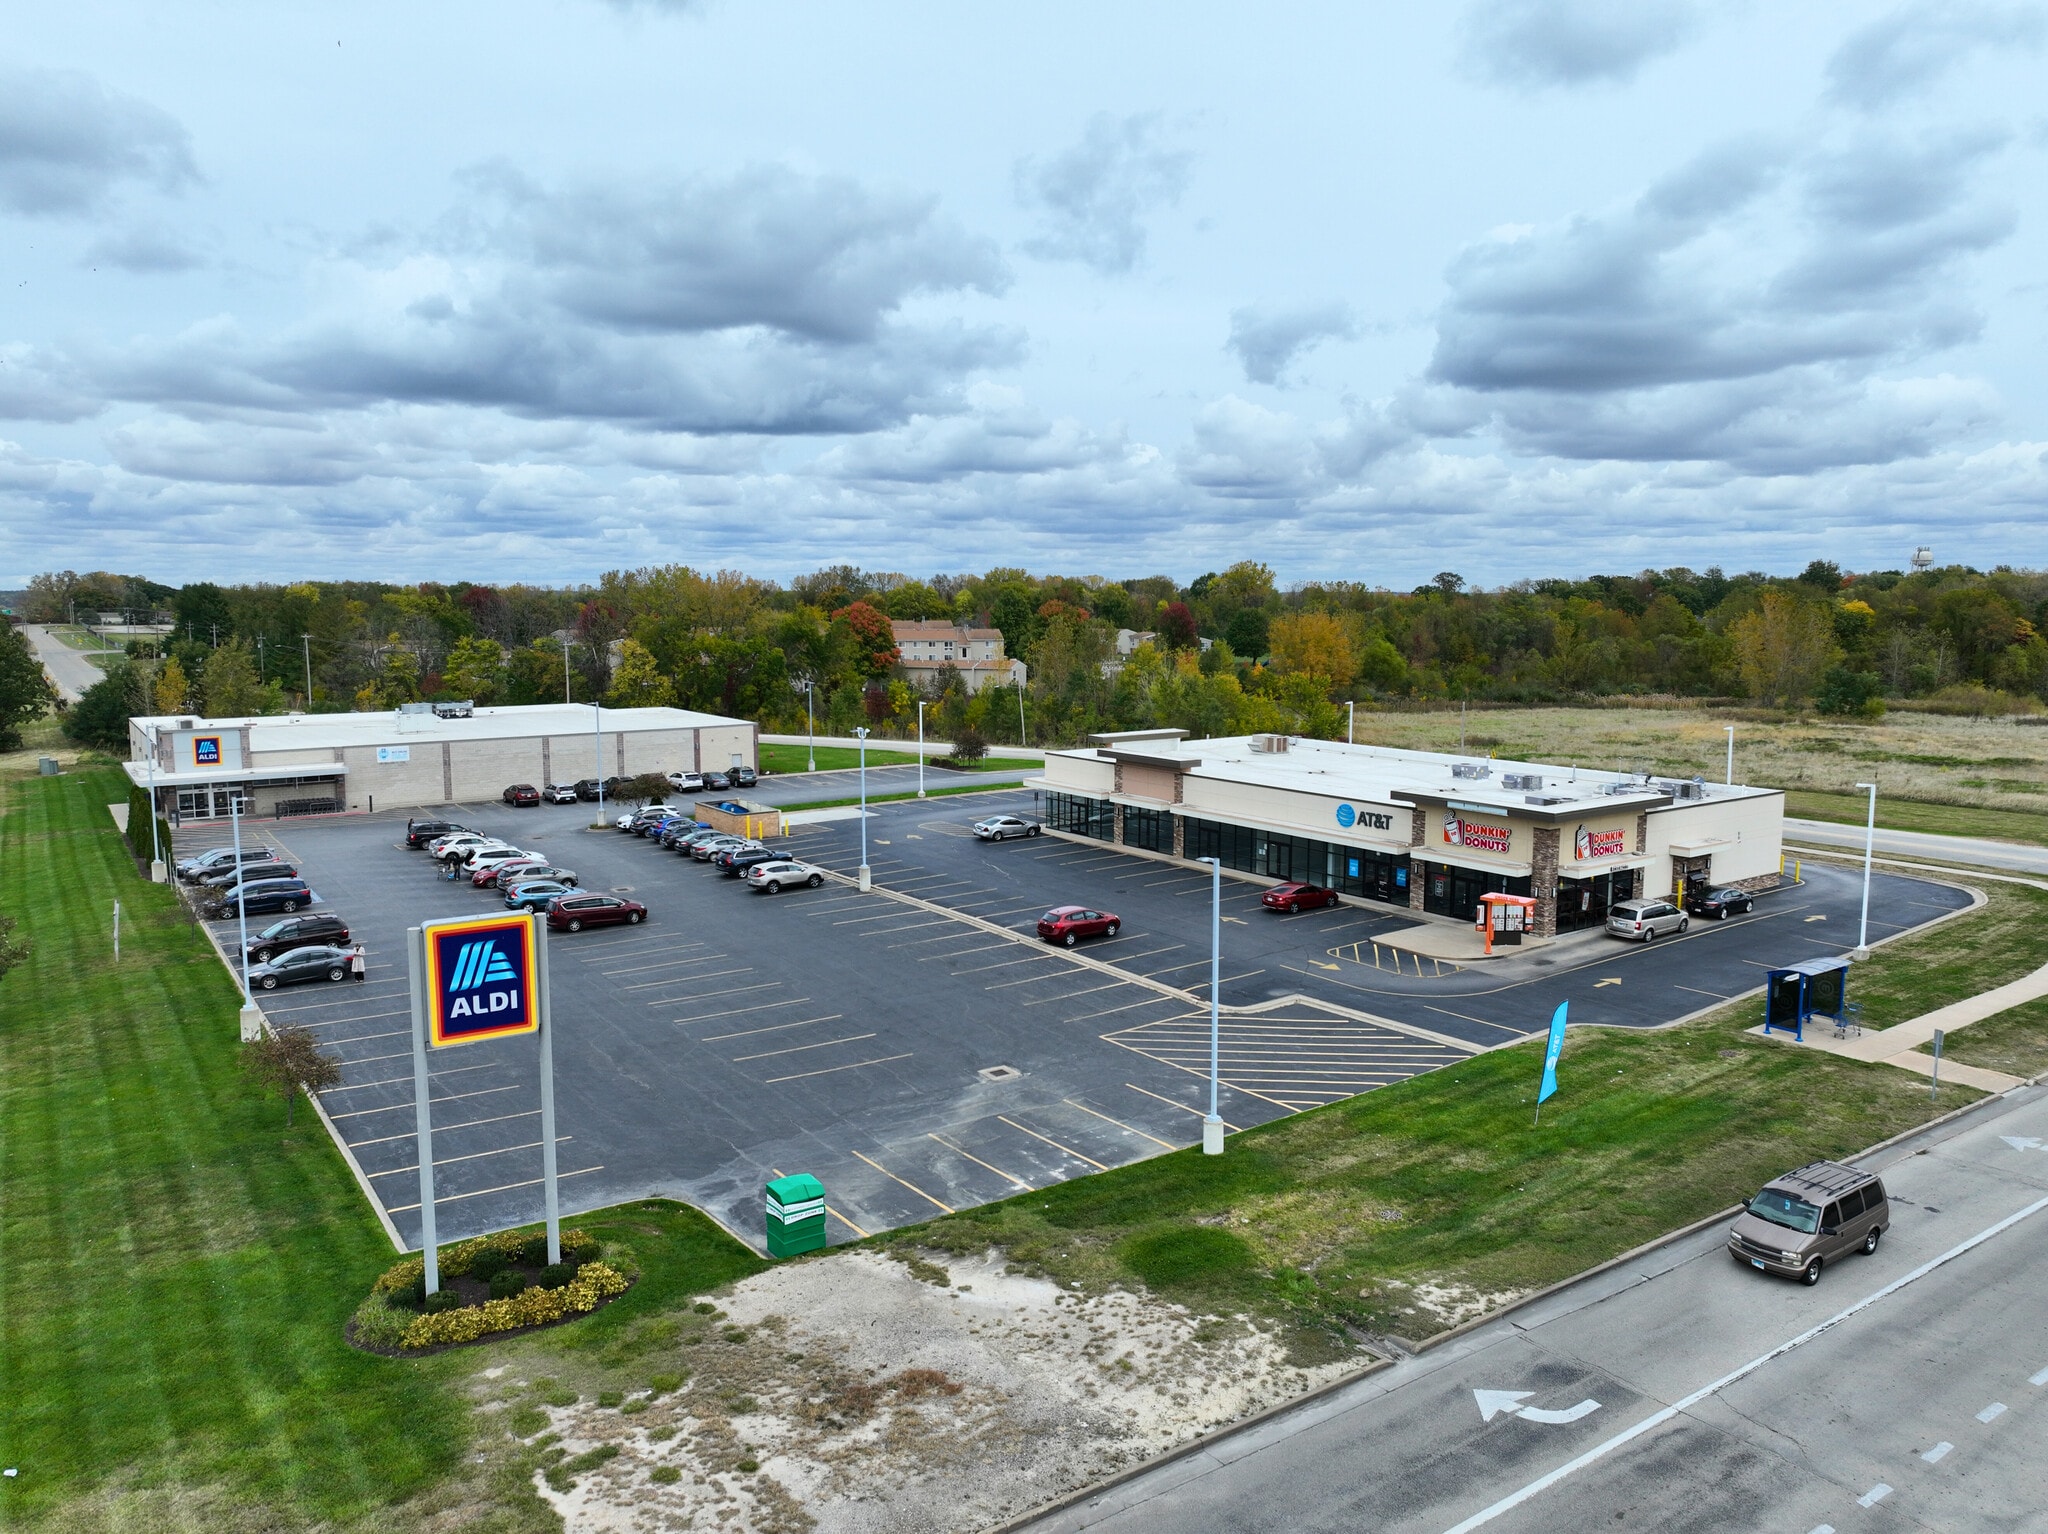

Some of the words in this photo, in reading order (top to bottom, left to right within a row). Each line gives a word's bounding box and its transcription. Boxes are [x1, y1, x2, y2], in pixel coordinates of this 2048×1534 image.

[198, 753, 218, 761] ALDI
[1357, 811, 1393, 830] AT&T
[1465, 823, 1511, 839] DUNKIN'
[1593, 830, 1626, 844] DUNKIN'
[1465, 836, 1508, 853] DONUTS
[1593, 842, 1624, 857] DONUTS
[450, 989, 518, 1019] ALDI
[1552, 1033, 1561, 1054] AT&T
